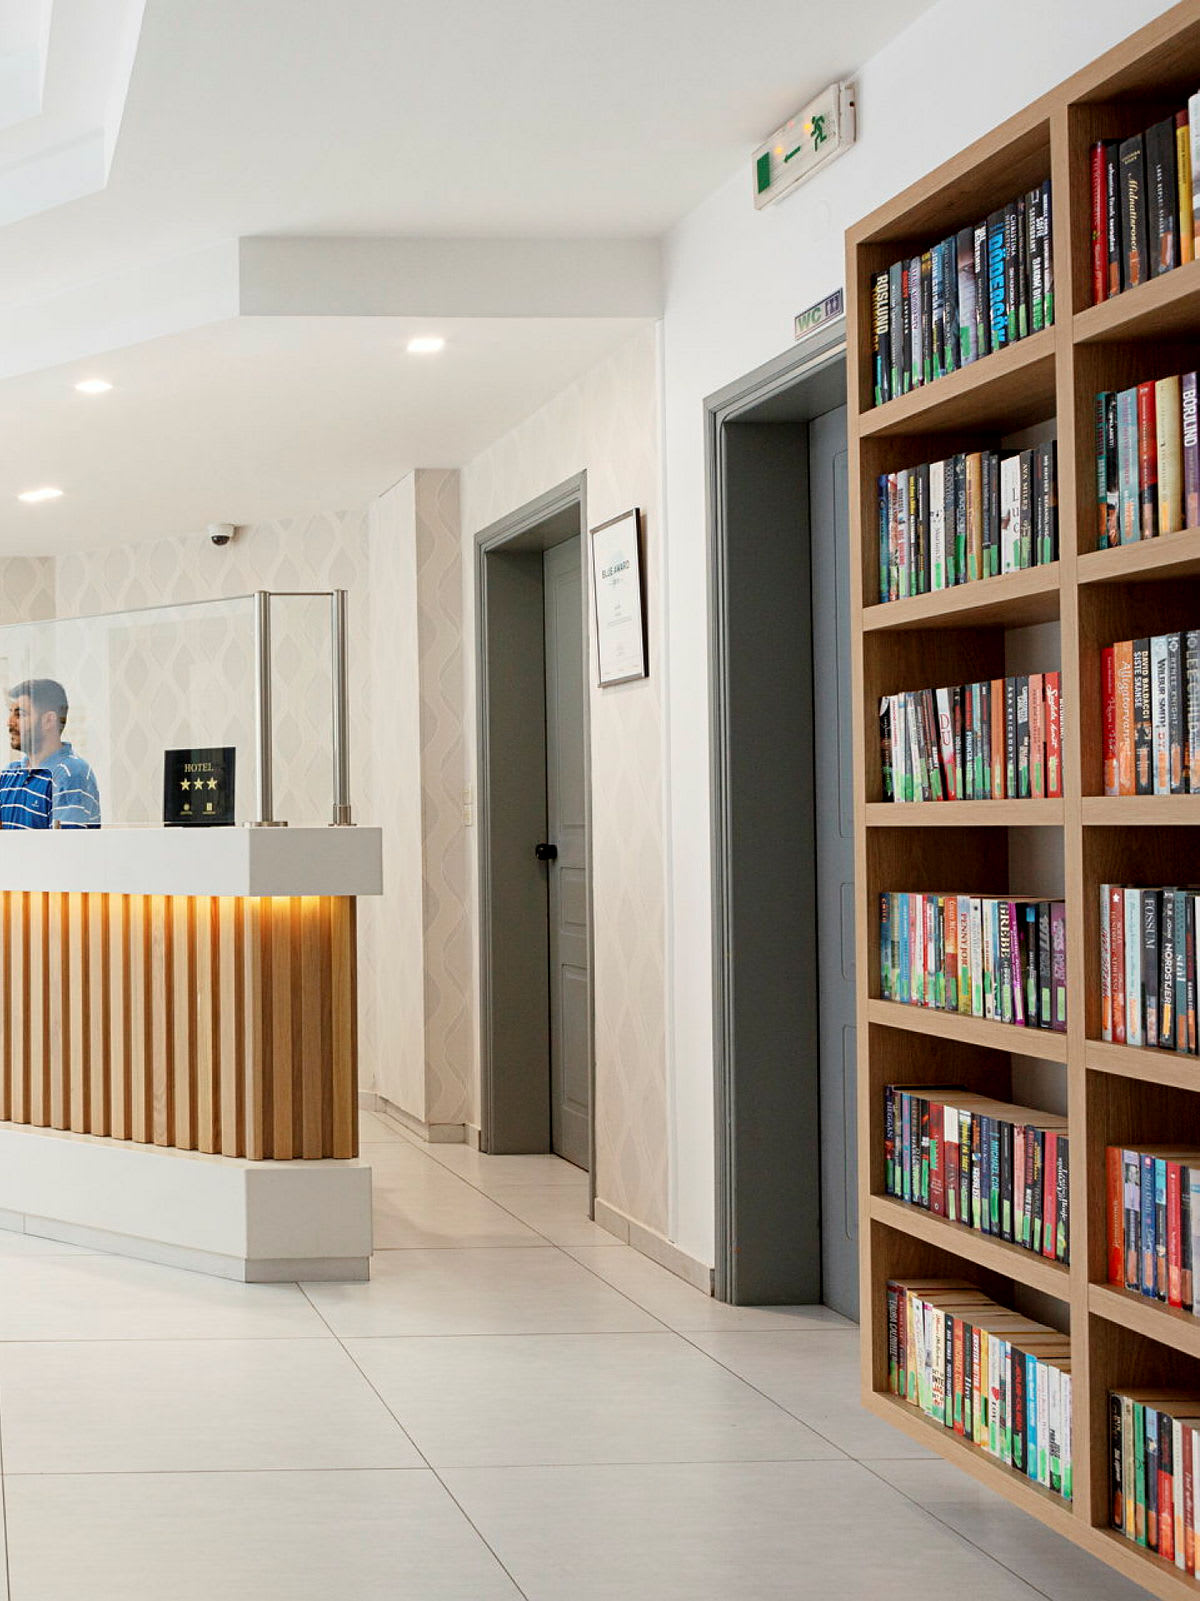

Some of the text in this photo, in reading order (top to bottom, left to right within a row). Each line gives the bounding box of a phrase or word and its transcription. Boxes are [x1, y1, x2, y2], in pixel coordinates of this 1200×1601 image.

[798, 307, 821, 330] WC
[877, 275, 889, 335] ROSLUND
[1156, 658, 1166, 695] WILBUR
[1142, 678, 1150, 719] BALDACCI
[184, 763, 213, 773] HOTEL
[960, 913, 968, 944] PENNY
[1000, 904, 1010, 958] GREBE
[1144, 898, 1156, 949] FOSSUM
